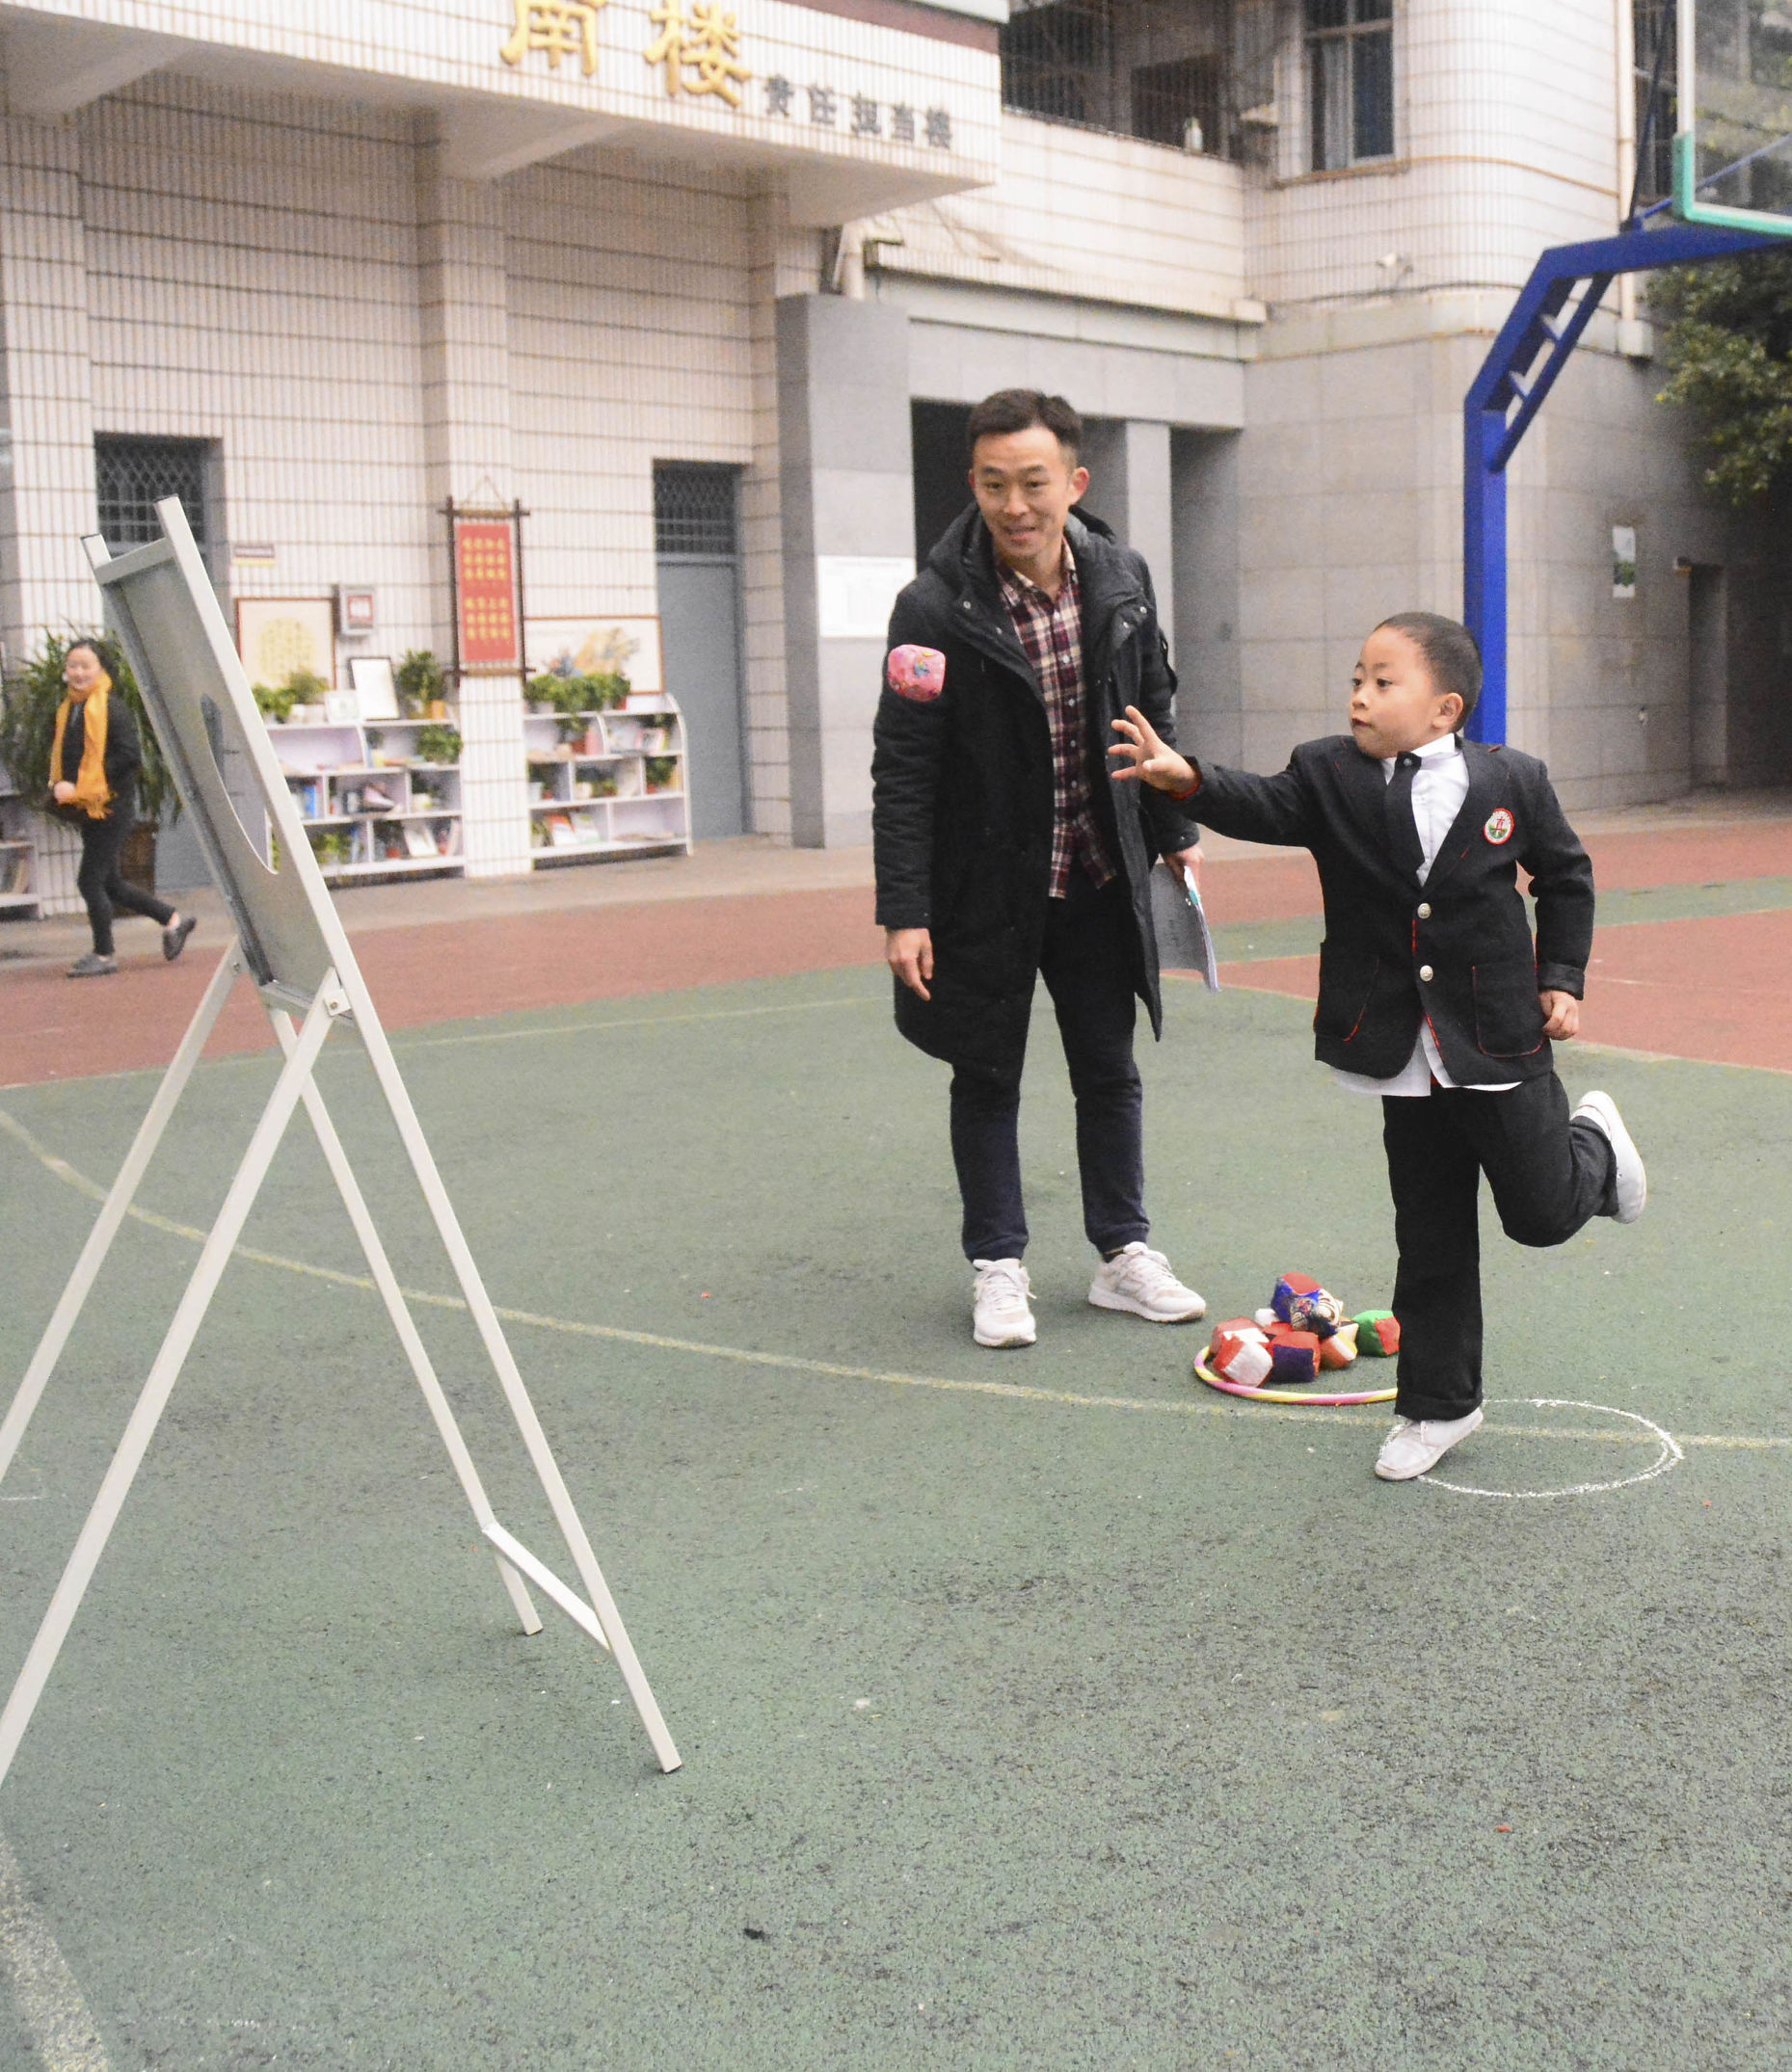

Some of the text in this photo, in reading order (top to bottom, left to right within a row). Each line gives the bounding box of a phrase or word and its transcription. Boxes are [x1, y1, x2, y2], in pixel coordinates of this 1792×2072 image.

[499, 0, 753, 108] 南楼
[764, 73, 952, 150] 责任担当楼
